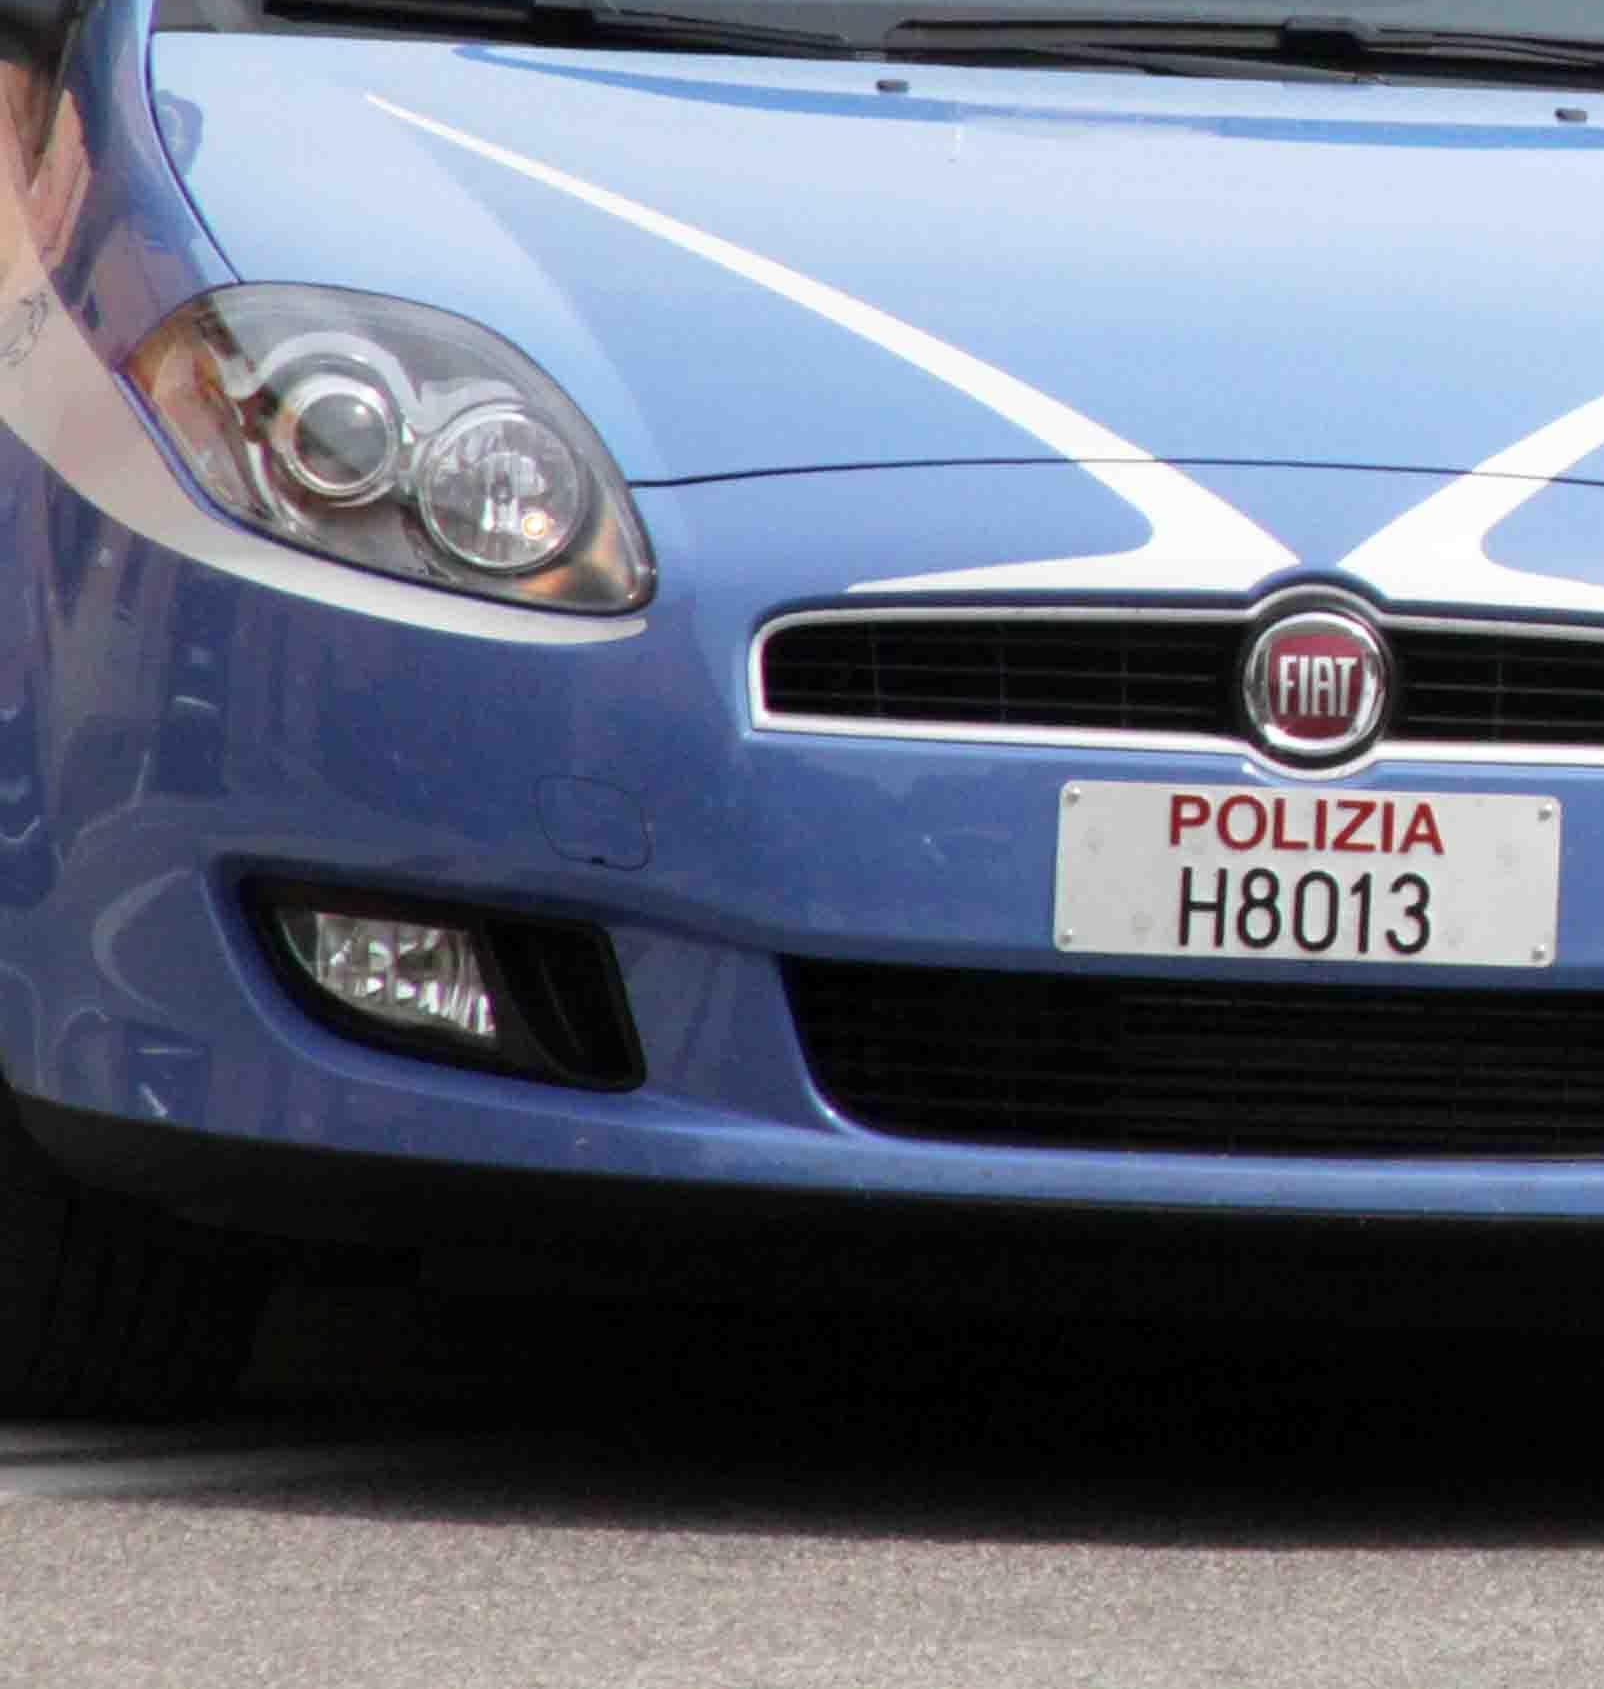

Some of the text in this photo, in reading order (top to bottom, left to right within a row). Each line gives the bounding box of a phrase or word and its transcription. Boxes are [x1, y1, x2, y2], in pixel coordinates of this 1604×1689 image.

[1278, 654, 1359, 718] FIAT
[1168, 793, 1445, 856] POLIZIA
[1177, 865, 1432, 955] H8013
